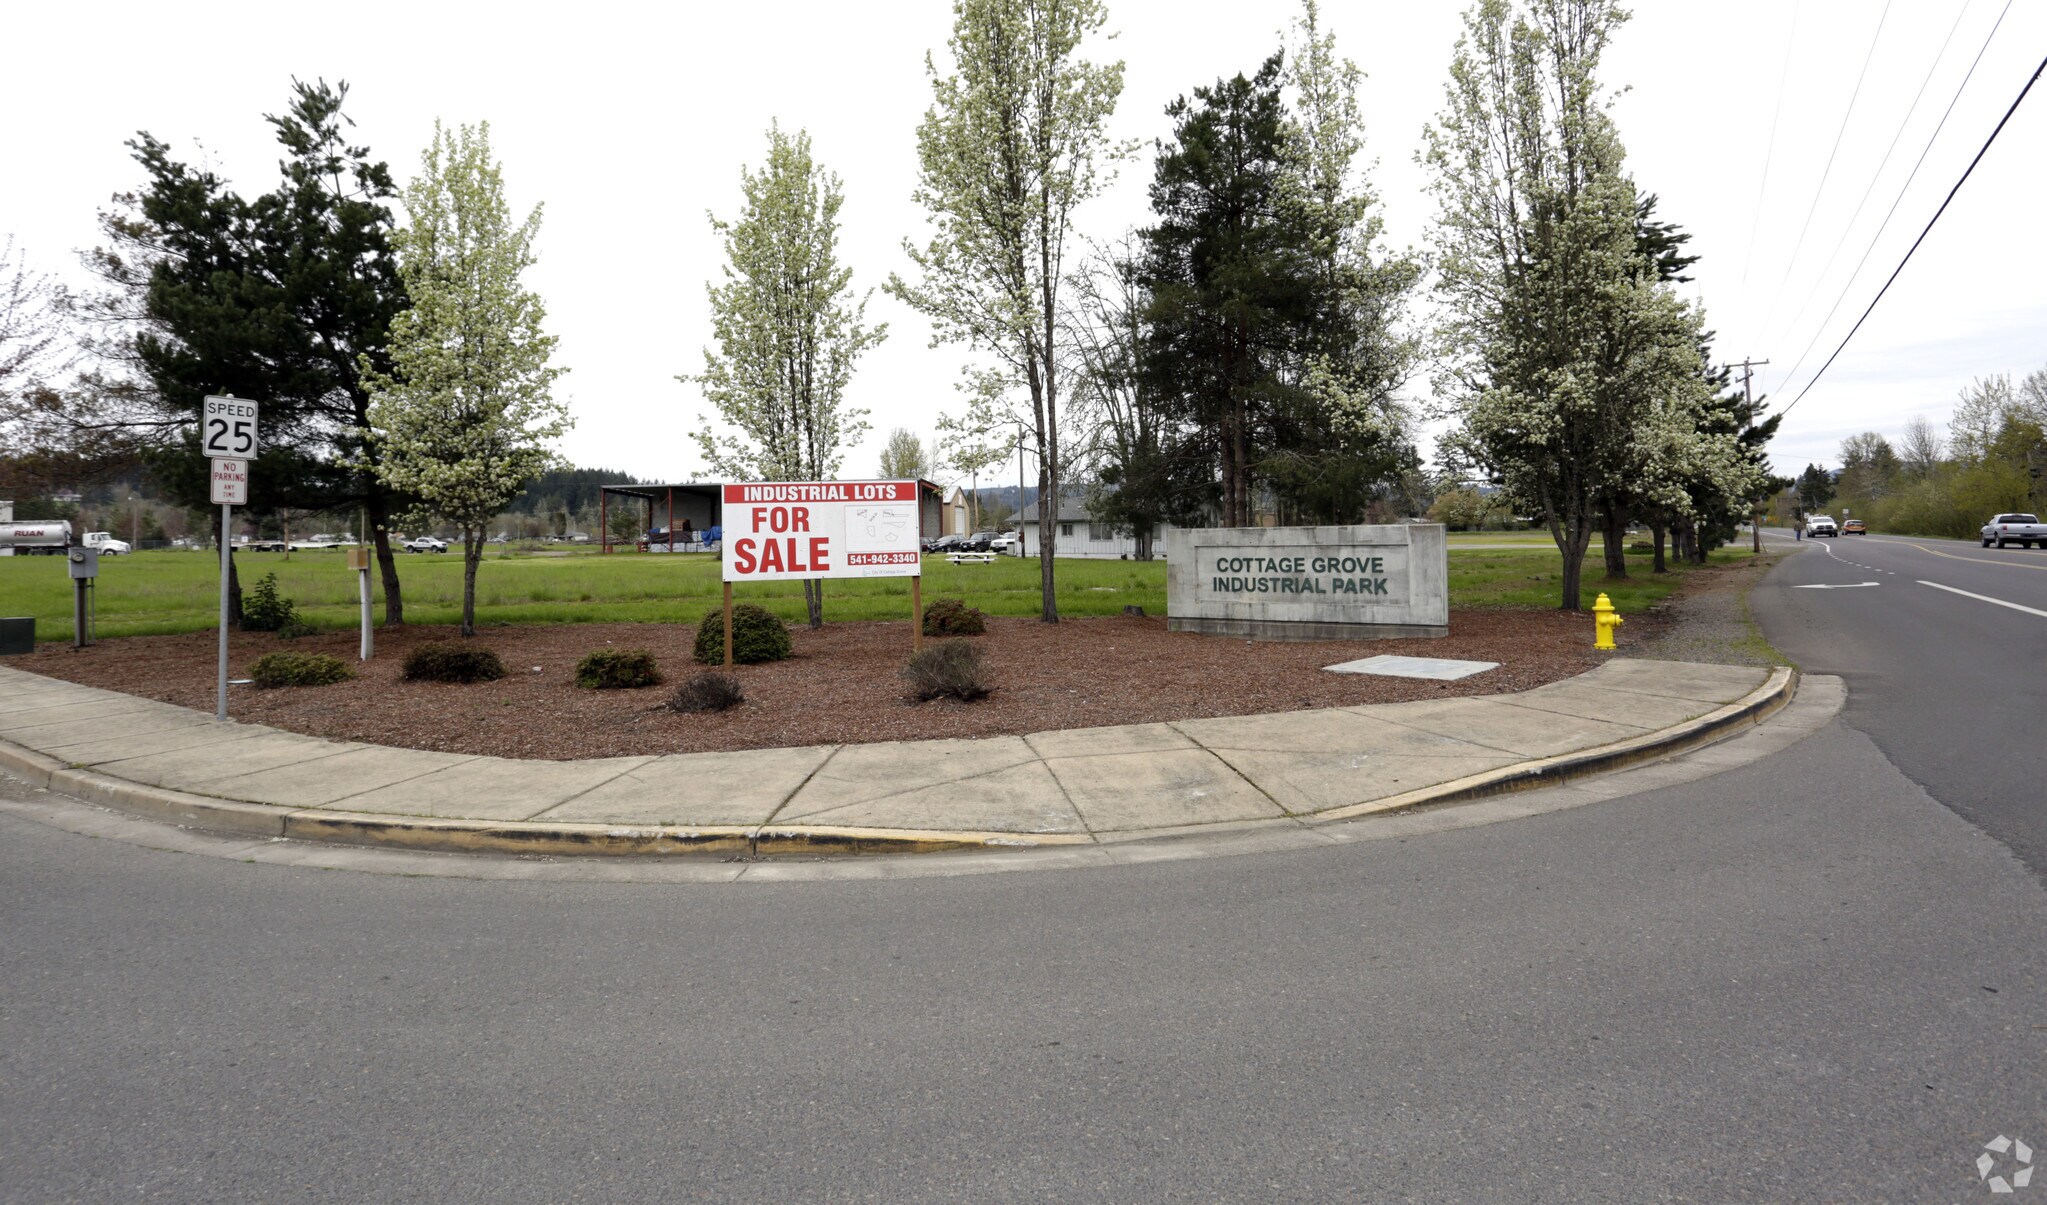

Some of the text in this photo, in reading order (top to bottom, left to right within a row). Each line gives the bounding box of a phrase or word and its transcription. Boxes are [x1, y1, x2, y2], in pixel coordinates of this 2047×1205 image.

[208, 402, 254, 418] SPEED
[208, 418, 252, 452] 25
[224, 463, 236, 472] NO
[214, 472, 244, 482] PARKING
[744, 484, 896, 501] INDUSTRIAL LOTS
[752, 506, 810, 533] FOR
[734, 537, 830, 574] SALE
[850, 554, 916, 564] 541-942-3340
[1216, 558, 1384, 573] COTTAGE GROVE
[1213, 577, 1388, 594] INDUSTRIAL PARK
